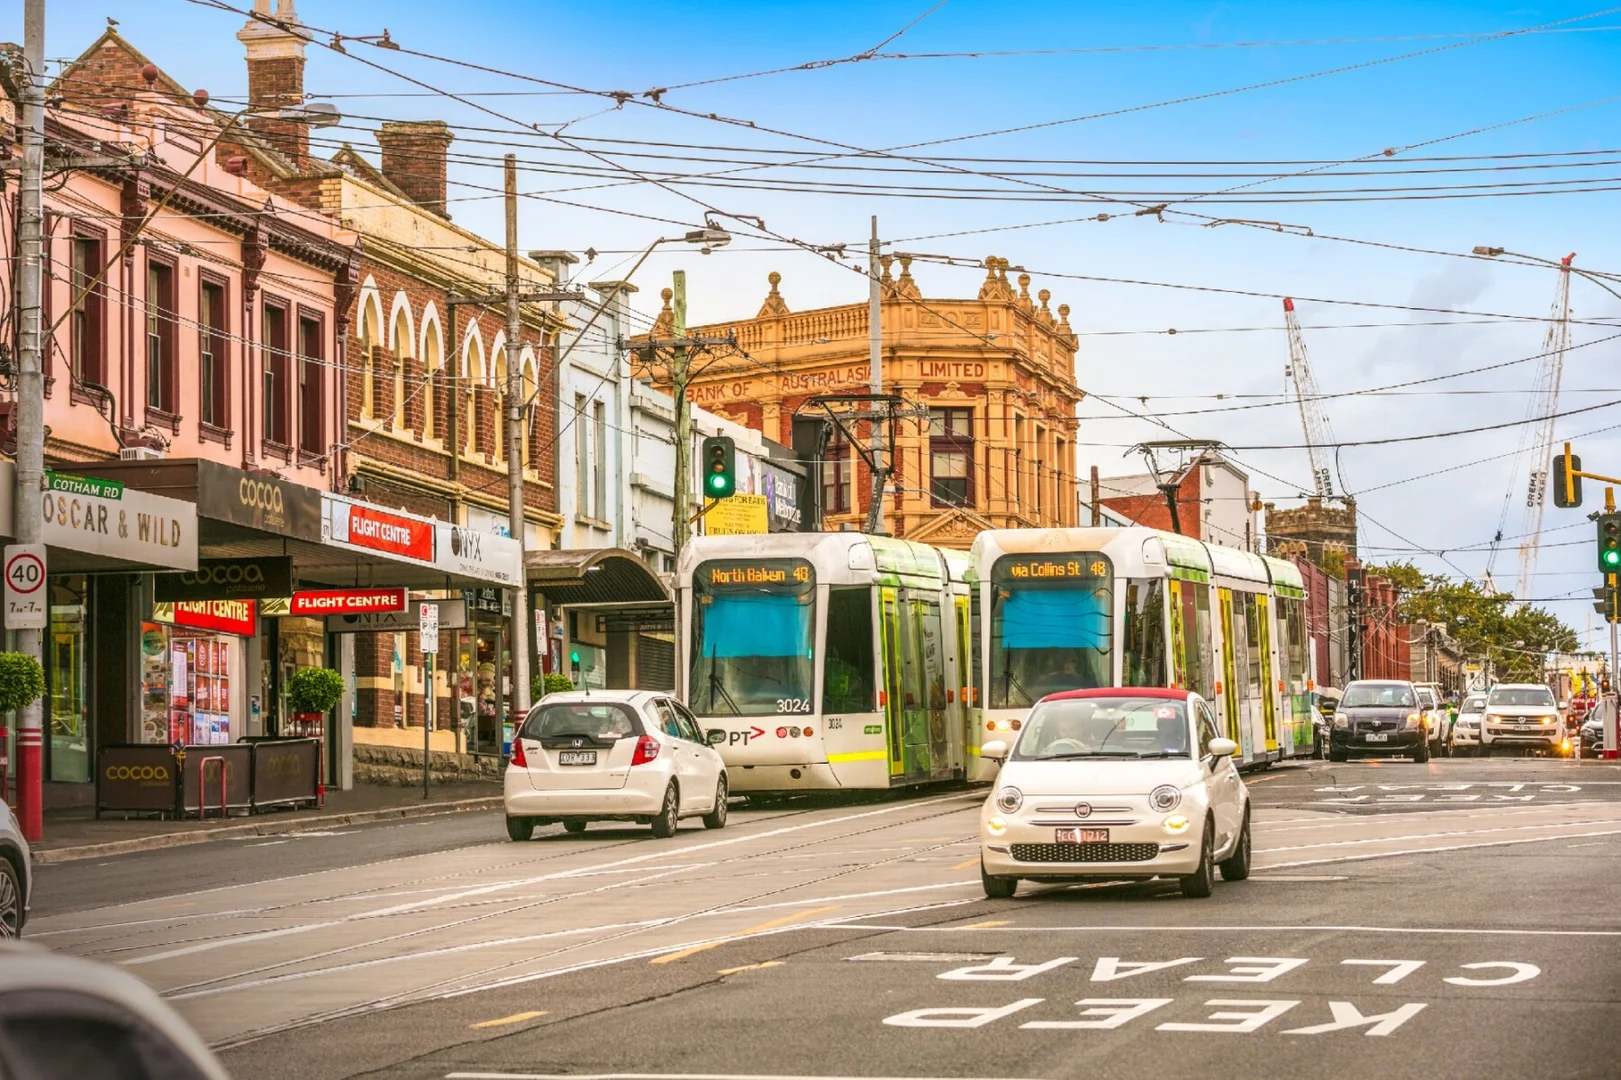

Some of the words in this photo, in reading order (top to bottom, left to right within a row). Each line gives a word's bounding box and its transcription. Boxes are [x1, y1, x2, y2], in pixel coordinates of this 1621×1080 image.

[920, 361, 984, 378] LIMITED
[686, 384, 725, 402] BANK
[732, 381, 752, 397] OF
[53, 479, 100, 496] COTHAM
[103, 486, 119, 498] RD
[1527, 472, 1538, 507] CREMA
[43, 493, 109, 535] OSCAR
[118, 509, 128, 538] &
[137, 512, 181, 548] WILD
[352, 516, 381, 540] FLIGHT
[381, 523, 411, 546] CENTRE
[12, 565, 38, 583] 40
[712, 567, 745, 583] North
[747, 567, 785, 583] Balwyn
[793, 567, 809, 582] 48
[1012, 565, 1028, 578] via
[1030, 562, 1064, 578] Collins
[1068, 563, 1081, 577] St
[1090, 561, 1106, 577] 48
[298, 596, 345, 608] FLIGHT
[346, 594, 398, 607] CENTRE
[212, 600, 249, 621] CENTRE
[776, 699, 810, 713] 3024
[828, 718, 843, 730] 3024
[936, 956, 1541, 987] CLEAR
[882, 997, 1428, 1037] KEEP
